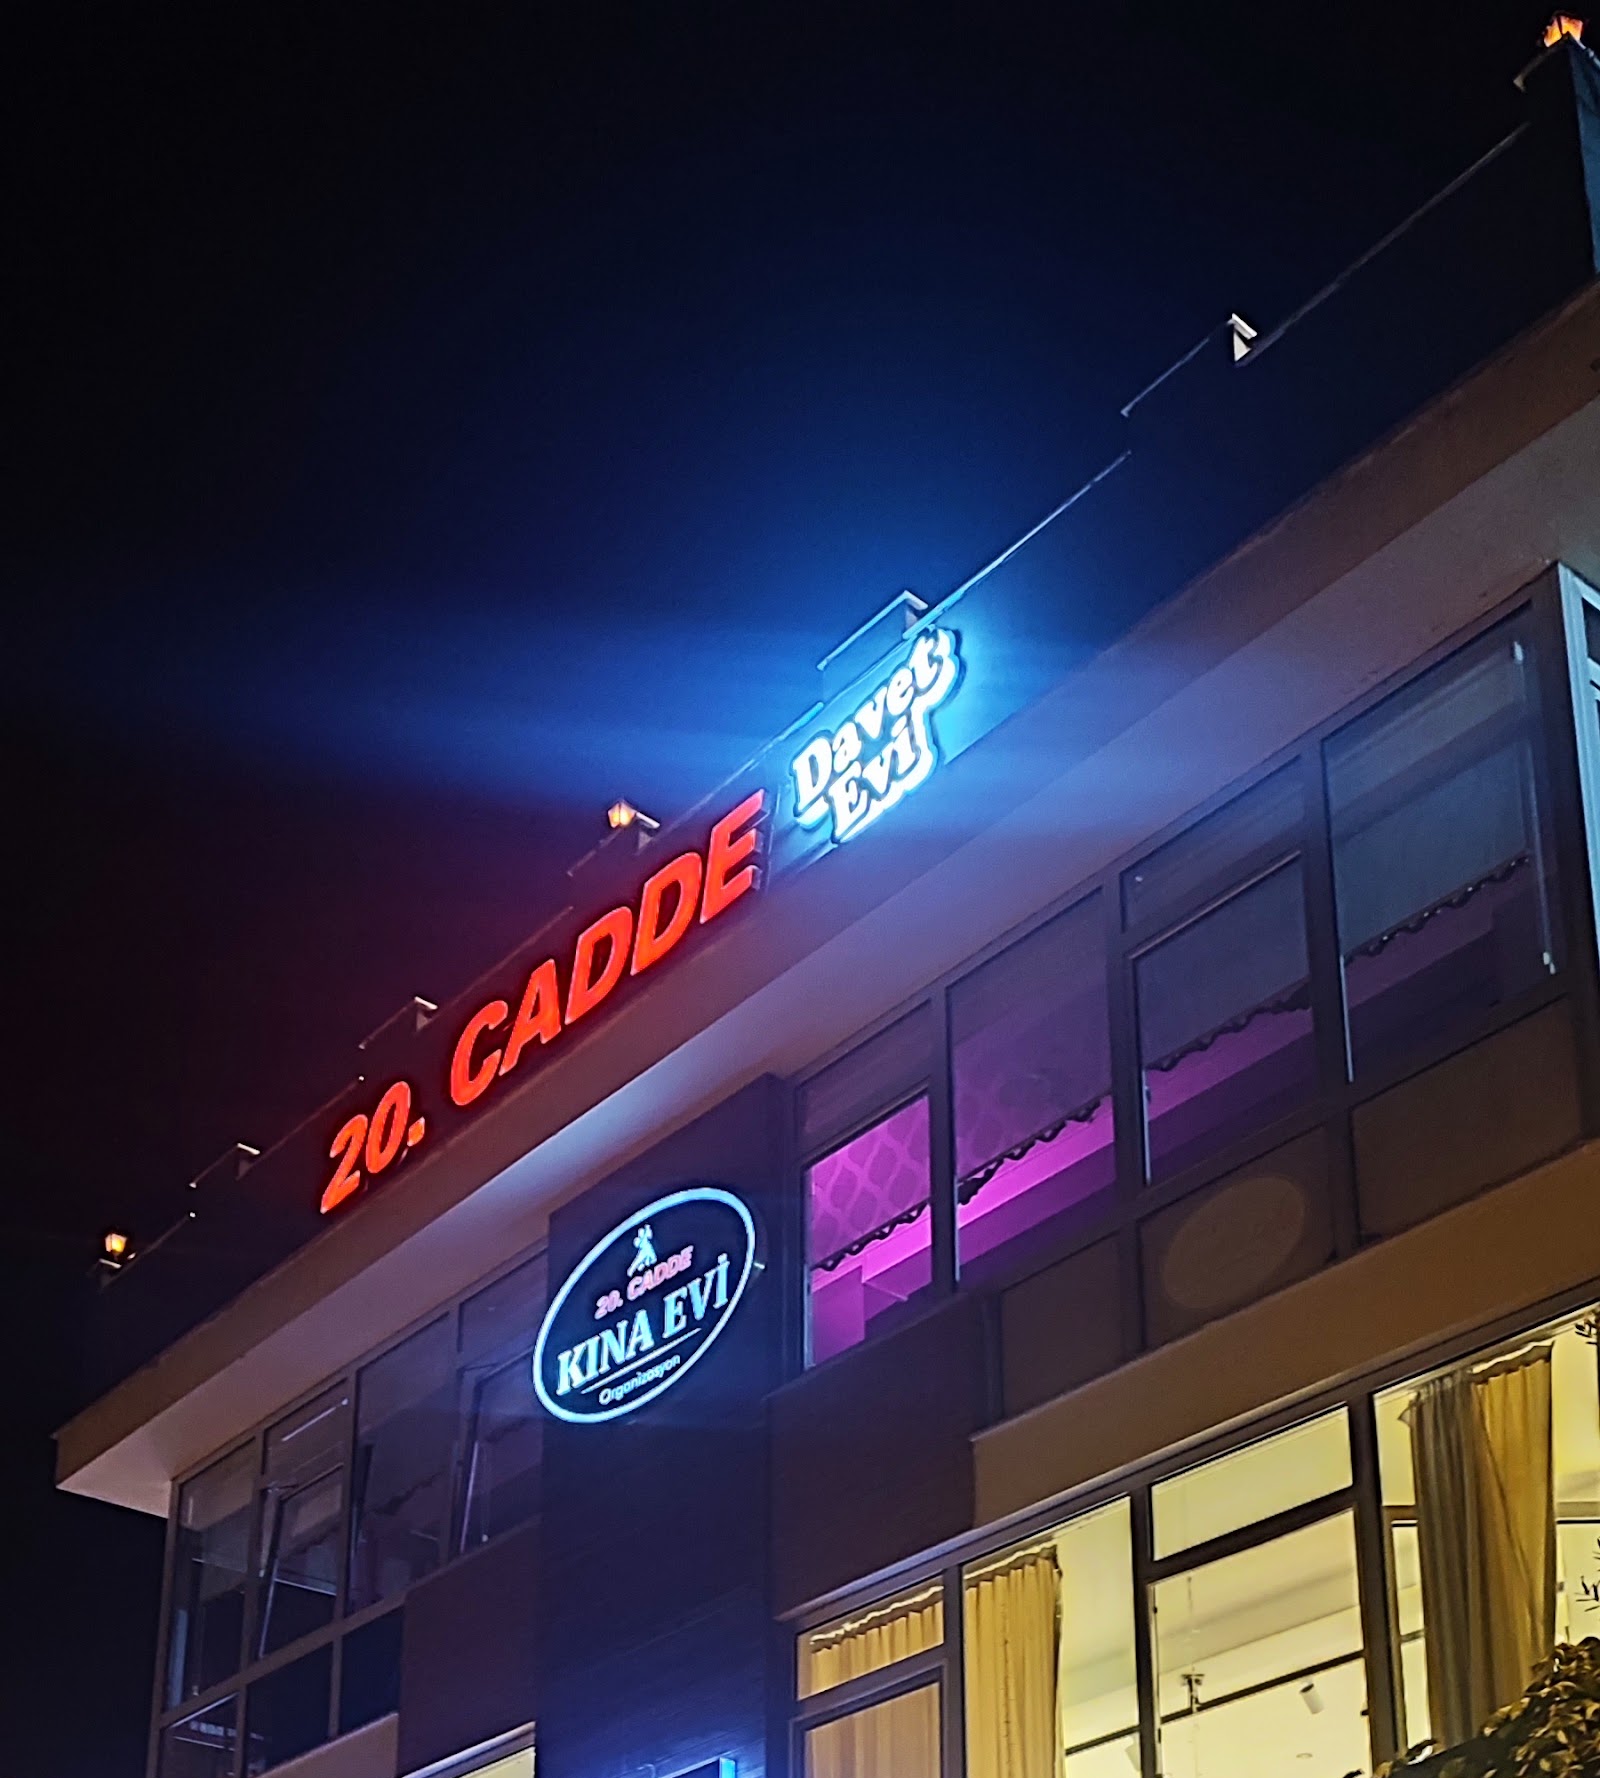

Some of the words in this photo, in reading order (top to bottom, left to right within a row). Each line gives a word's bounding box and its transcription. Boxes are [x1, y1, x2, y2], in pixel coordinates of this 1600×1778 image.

[791, 628, 950, 813] Davet
[827, 713, 920, 839] Evi
[320, 1080, 426, 1215] 20.
[450, 787, 767, 1107] CADDE
[556, 1309, 655, 1396] KINA
[662, 1252, 731, 1339] EVİ
[594, 1289, 624, 1320] 20.
[626, 1245, 694, 1301] CADDE
[598, 1354, 681, 1405] Organizasyon
